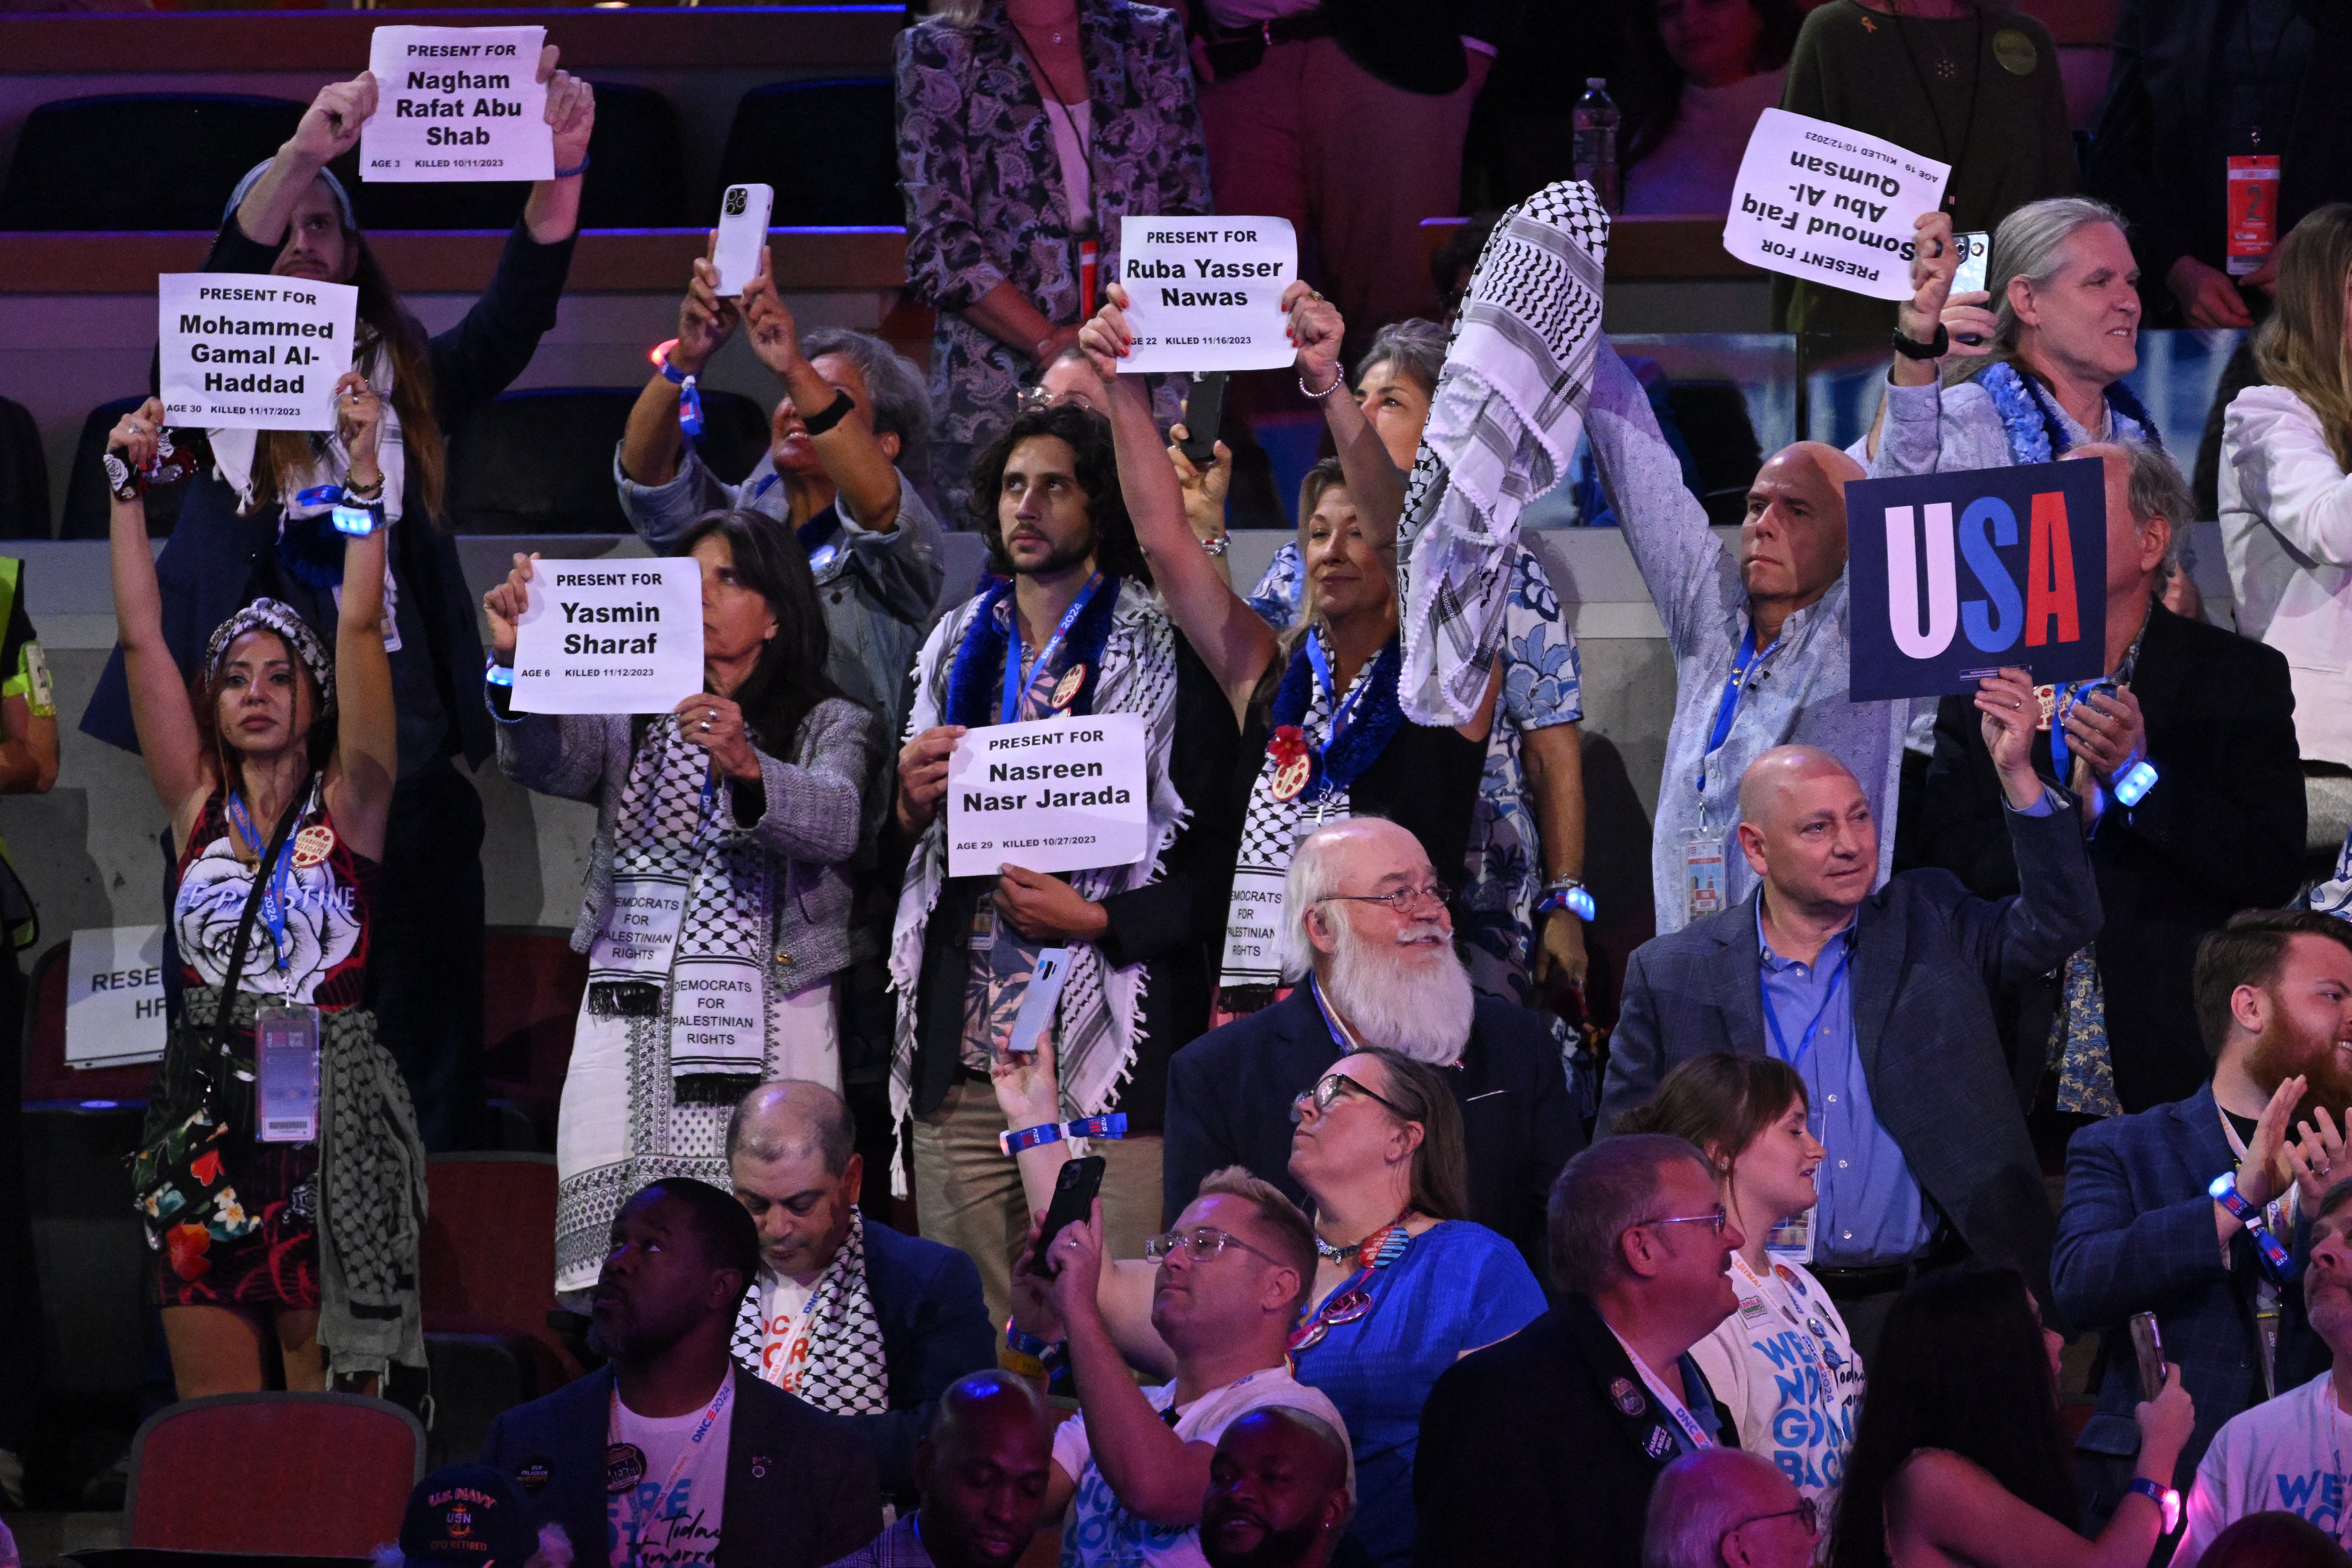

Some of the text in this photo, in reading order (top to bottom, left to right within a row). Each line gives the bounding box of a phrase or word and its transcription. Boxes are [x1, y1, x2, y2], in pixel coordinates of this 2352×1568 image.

[408, 44, 516, 57] PRESENT FOR
[407, 70, 509, 94] Nagham
[396, 98, 521, 118] Rafat Abu
[426, 126, 490, 146] Shab
[453, 159, 503, 167] 10/11/2023
[1805, 131, 1938, 183] AGE 19 KILLED 10/12/2023
[1791, 151, 1900, 197] Qumsan
[1789, 183, 1888, 223] Abu Al-
[2247, 184, 2263, 220] 2
[1147, 231, 1258, 243] PRESENT FOR
[1742, 193, 1915, 261] Somoud Faiq
[1127, 259, 1283, 279] Ruba Yasser
[1761, 239, 1880, 281] PRESENT FOR
[200, 287, 316, 305] PRESENT FOR
[1161, 288, 1248, 306] Nawas
[179, 314, 333, 339] Mohammed
[1130, 337, 1143, 345] GE
[191, 343, 319, 365] Gamal Al-
[205, 372, 304, 394] Haddad
[166, 404, 300, 416] AGE 30 KILLED 11/17/2023
[557, 573, 662, 586] PRESENT FOR
[1885, 491, 2080, 659] USA
[560, 601, 659, 623] Yasmin
[1041, 603, 1083, 659] DNC 2024
[564, 632, 657, 655] Sharaf
[989, 730, 1104, 751] PRESENT FOR
[990, 762, 1102, 782] Nasreen
[963, 785, 1130, 812] Nasr Jarada
[298, 837, 328, 849] CEASEFIRE
[956, 842, 977, 850] AGE
[1002, 839, 1039, 848] KILLED
[1043, 836, 1096, 846] 10/27/2023
[614, 897, 679, 910] EMOCRATS
[1231, 891, 1282, 904] EMOCRATS
[264, 894, 278, 922] 2024
[1237, 909, 1254, 919] FOR
[624, 914, 649, 926] FOR
[599, 930, 672, 944] PALESTINIAN
[612, 948, 655, 960] RIGHTS
[1233, 945, 1261, 957] RIGHTS
[675, 979, 753, 992] DEMOCRATS
[698, 998, 725, 1009] FOR
[673, 1016, 753, 1028] PALESTINIAN
[687, 1033, 736, 1045] RIGHTS
[2269, 1202, 2280, 1226] 024
[803, 1291, 820, 1314] DNC
[1820, 1370, 1834, 1404] 2024
[691, 1385, 731, 1443] DNC 2024
[1676, 1408, 1698, 1435] DNC
[454, 1487, 497, 1509] NAVY
[446, 1513, 472, 1524] USN
[450, 1540, 489, 1551] RETIRED
